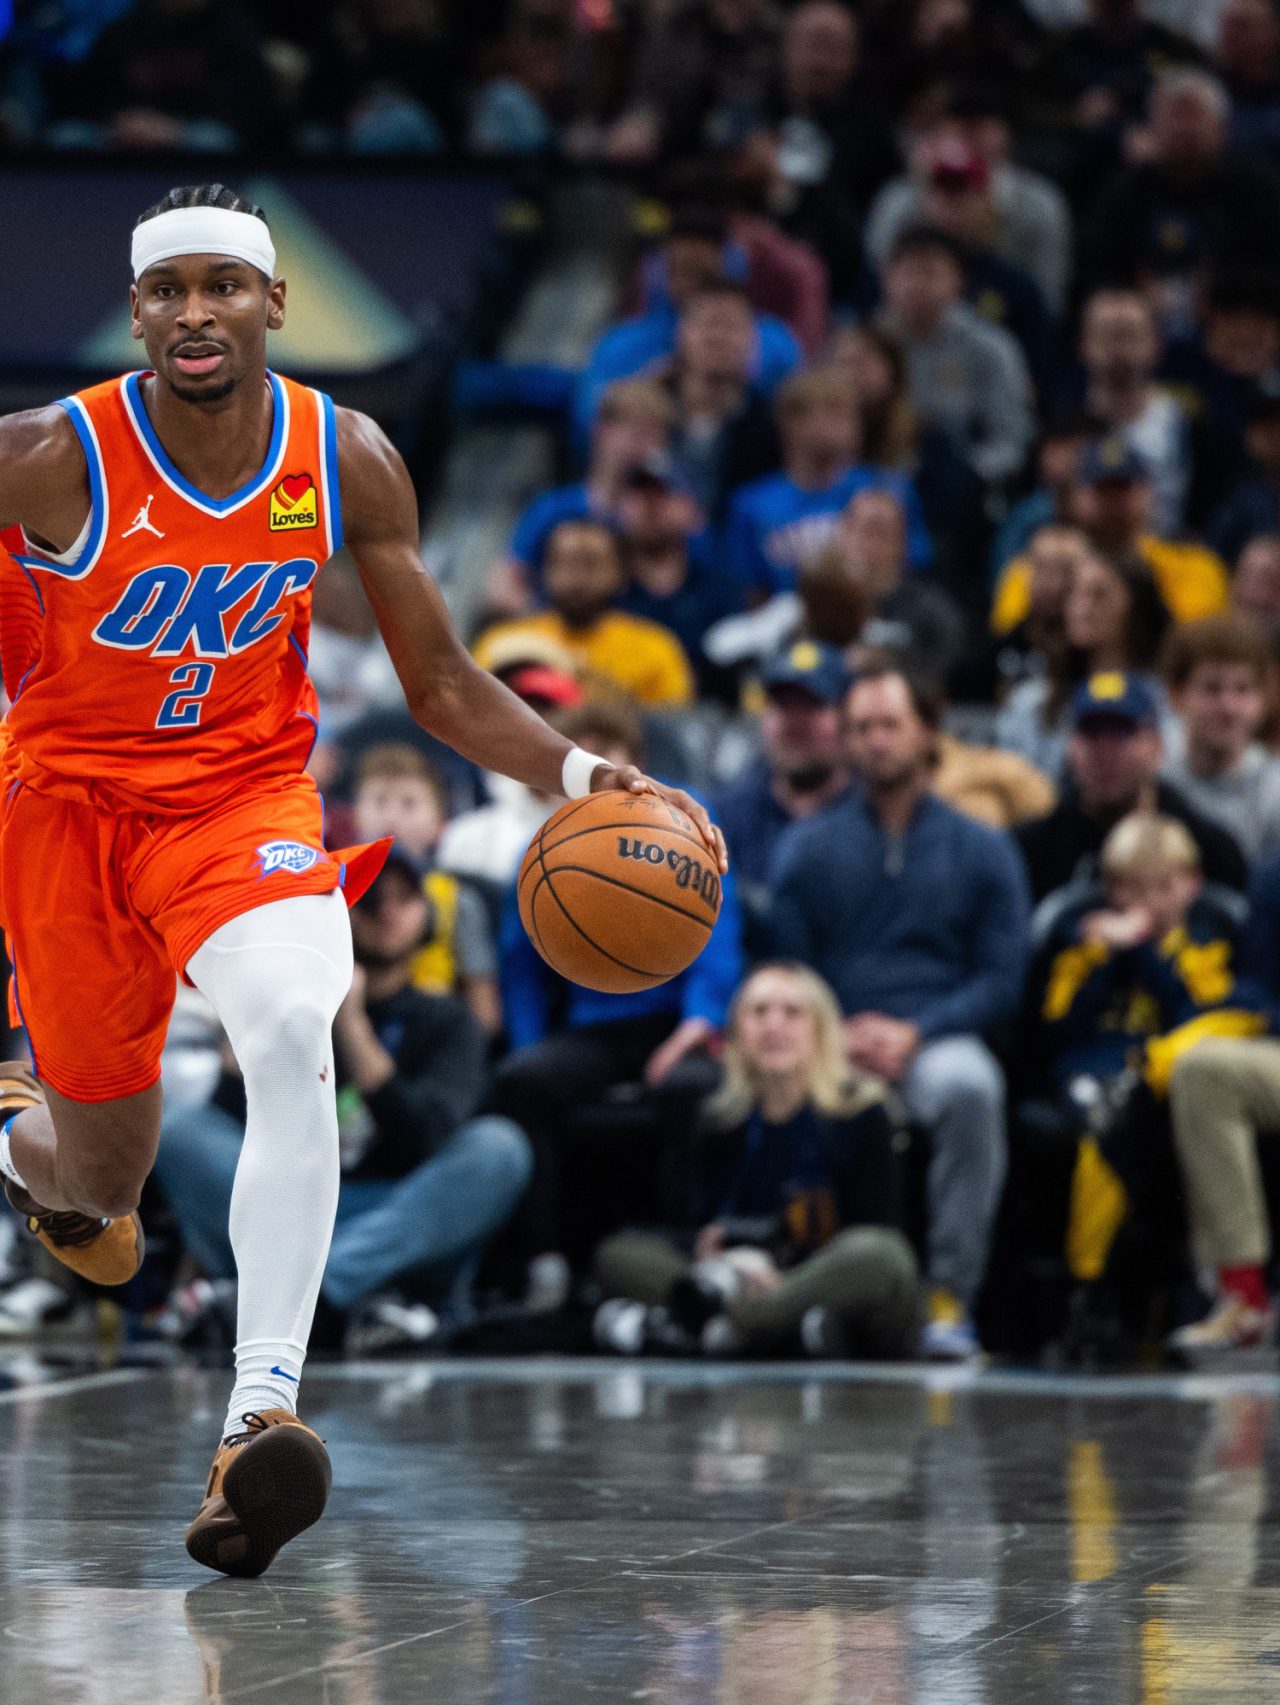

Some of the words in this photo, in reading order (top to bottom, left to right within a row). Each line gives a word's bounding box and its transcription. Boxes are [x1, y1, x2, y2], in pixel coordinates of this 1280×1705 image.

[91, 558, 318, 659] OKC
[155, 662, 216, 729] 2
[617, 835, 719, 913] Wilson
